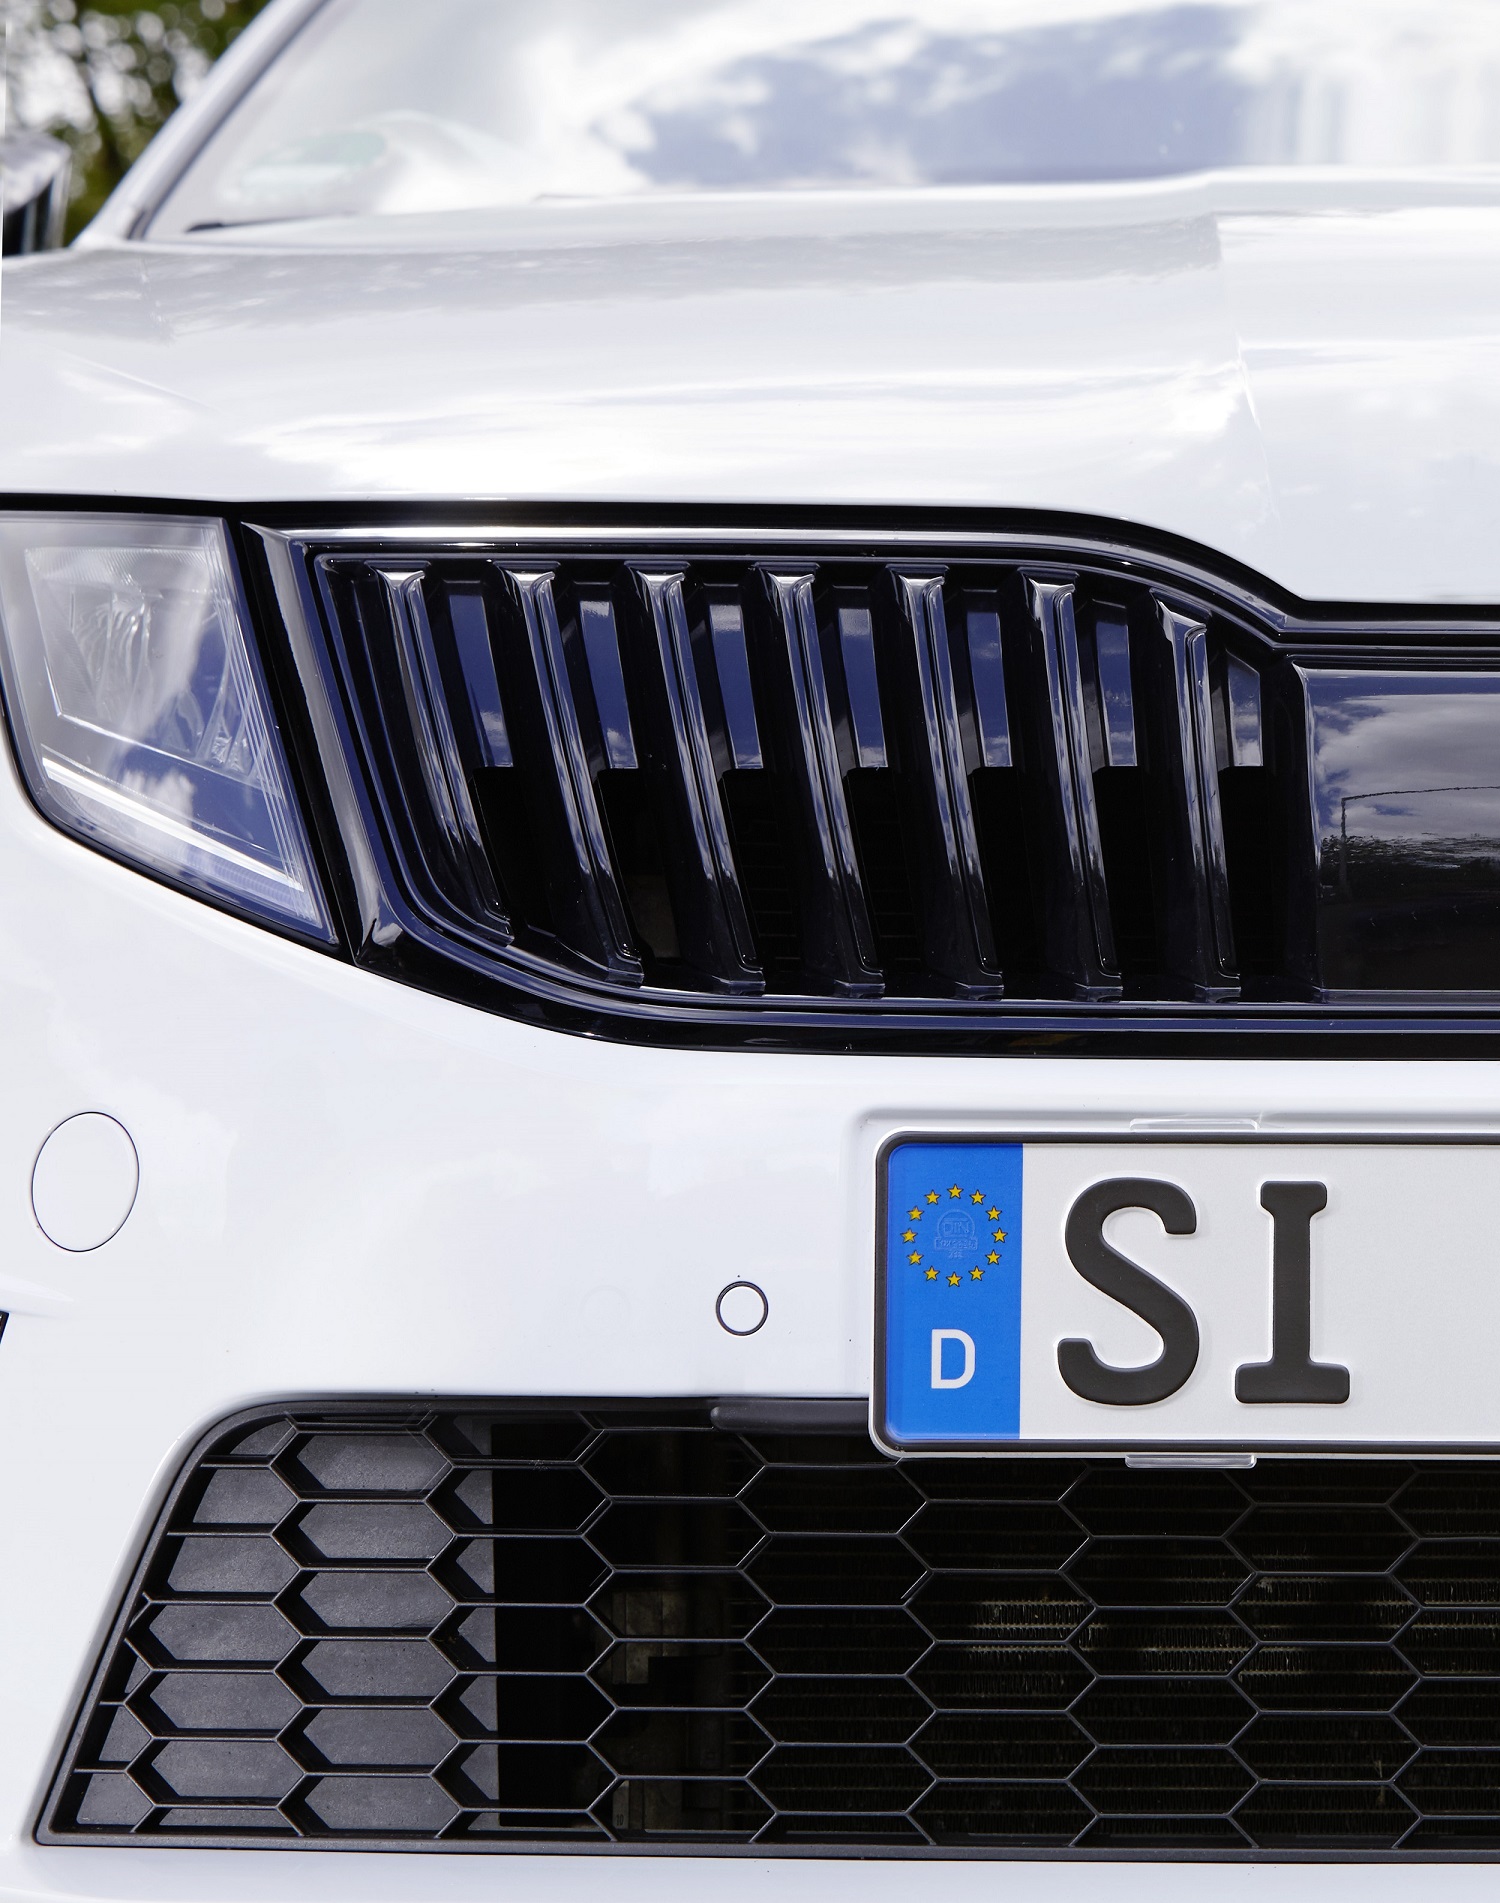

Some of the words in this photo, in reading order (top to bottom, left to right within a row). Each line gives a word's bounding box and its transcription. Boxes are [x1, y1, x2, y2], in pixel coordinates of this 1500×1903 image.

[943, 1221, 970, 1235] DIN
[1057, 1178, 1351, 1406] SI
[931, 1329, 976, 1389] D
